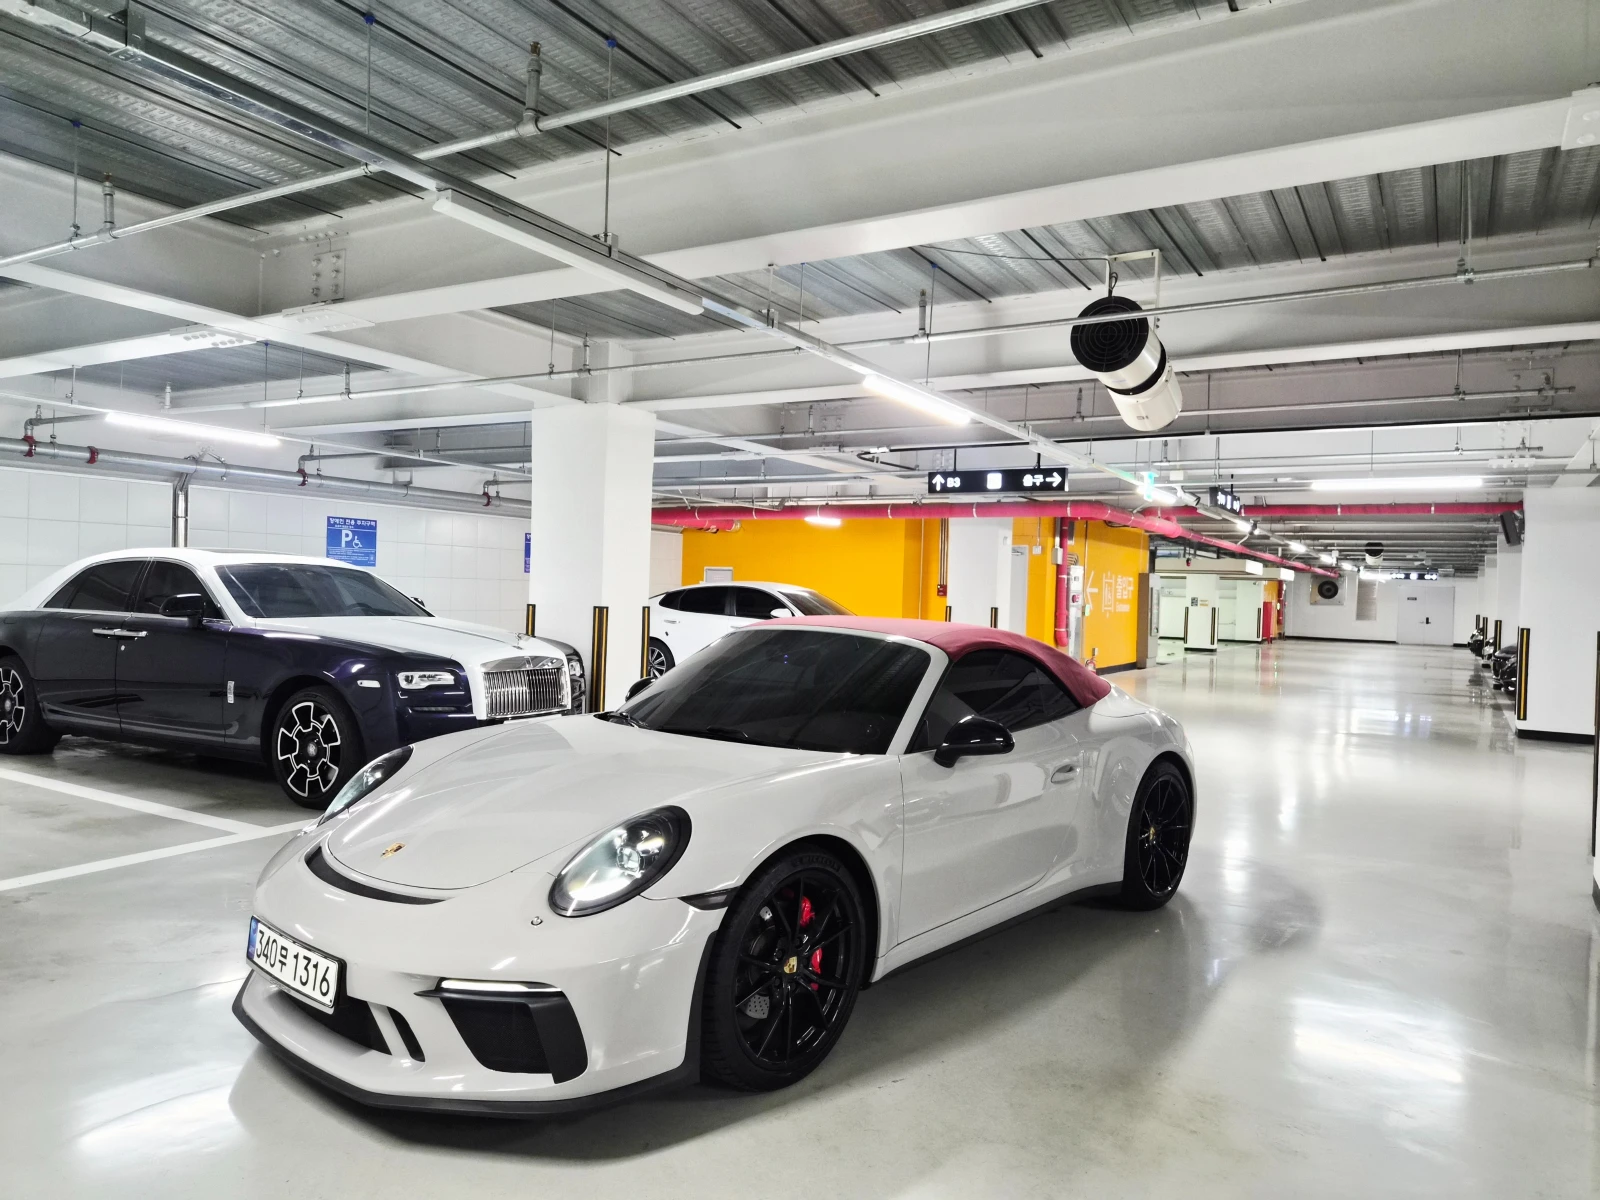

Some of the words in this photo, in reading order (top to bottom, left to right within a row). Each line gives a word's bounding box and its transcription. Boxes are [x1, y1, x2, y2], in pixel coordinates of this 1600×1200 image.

[947, 477, 960, 487] B3
[341, 529, 353, 548] P
[256, 930, 288, 972] 340무
[293, 952, 330, 997] 1316
